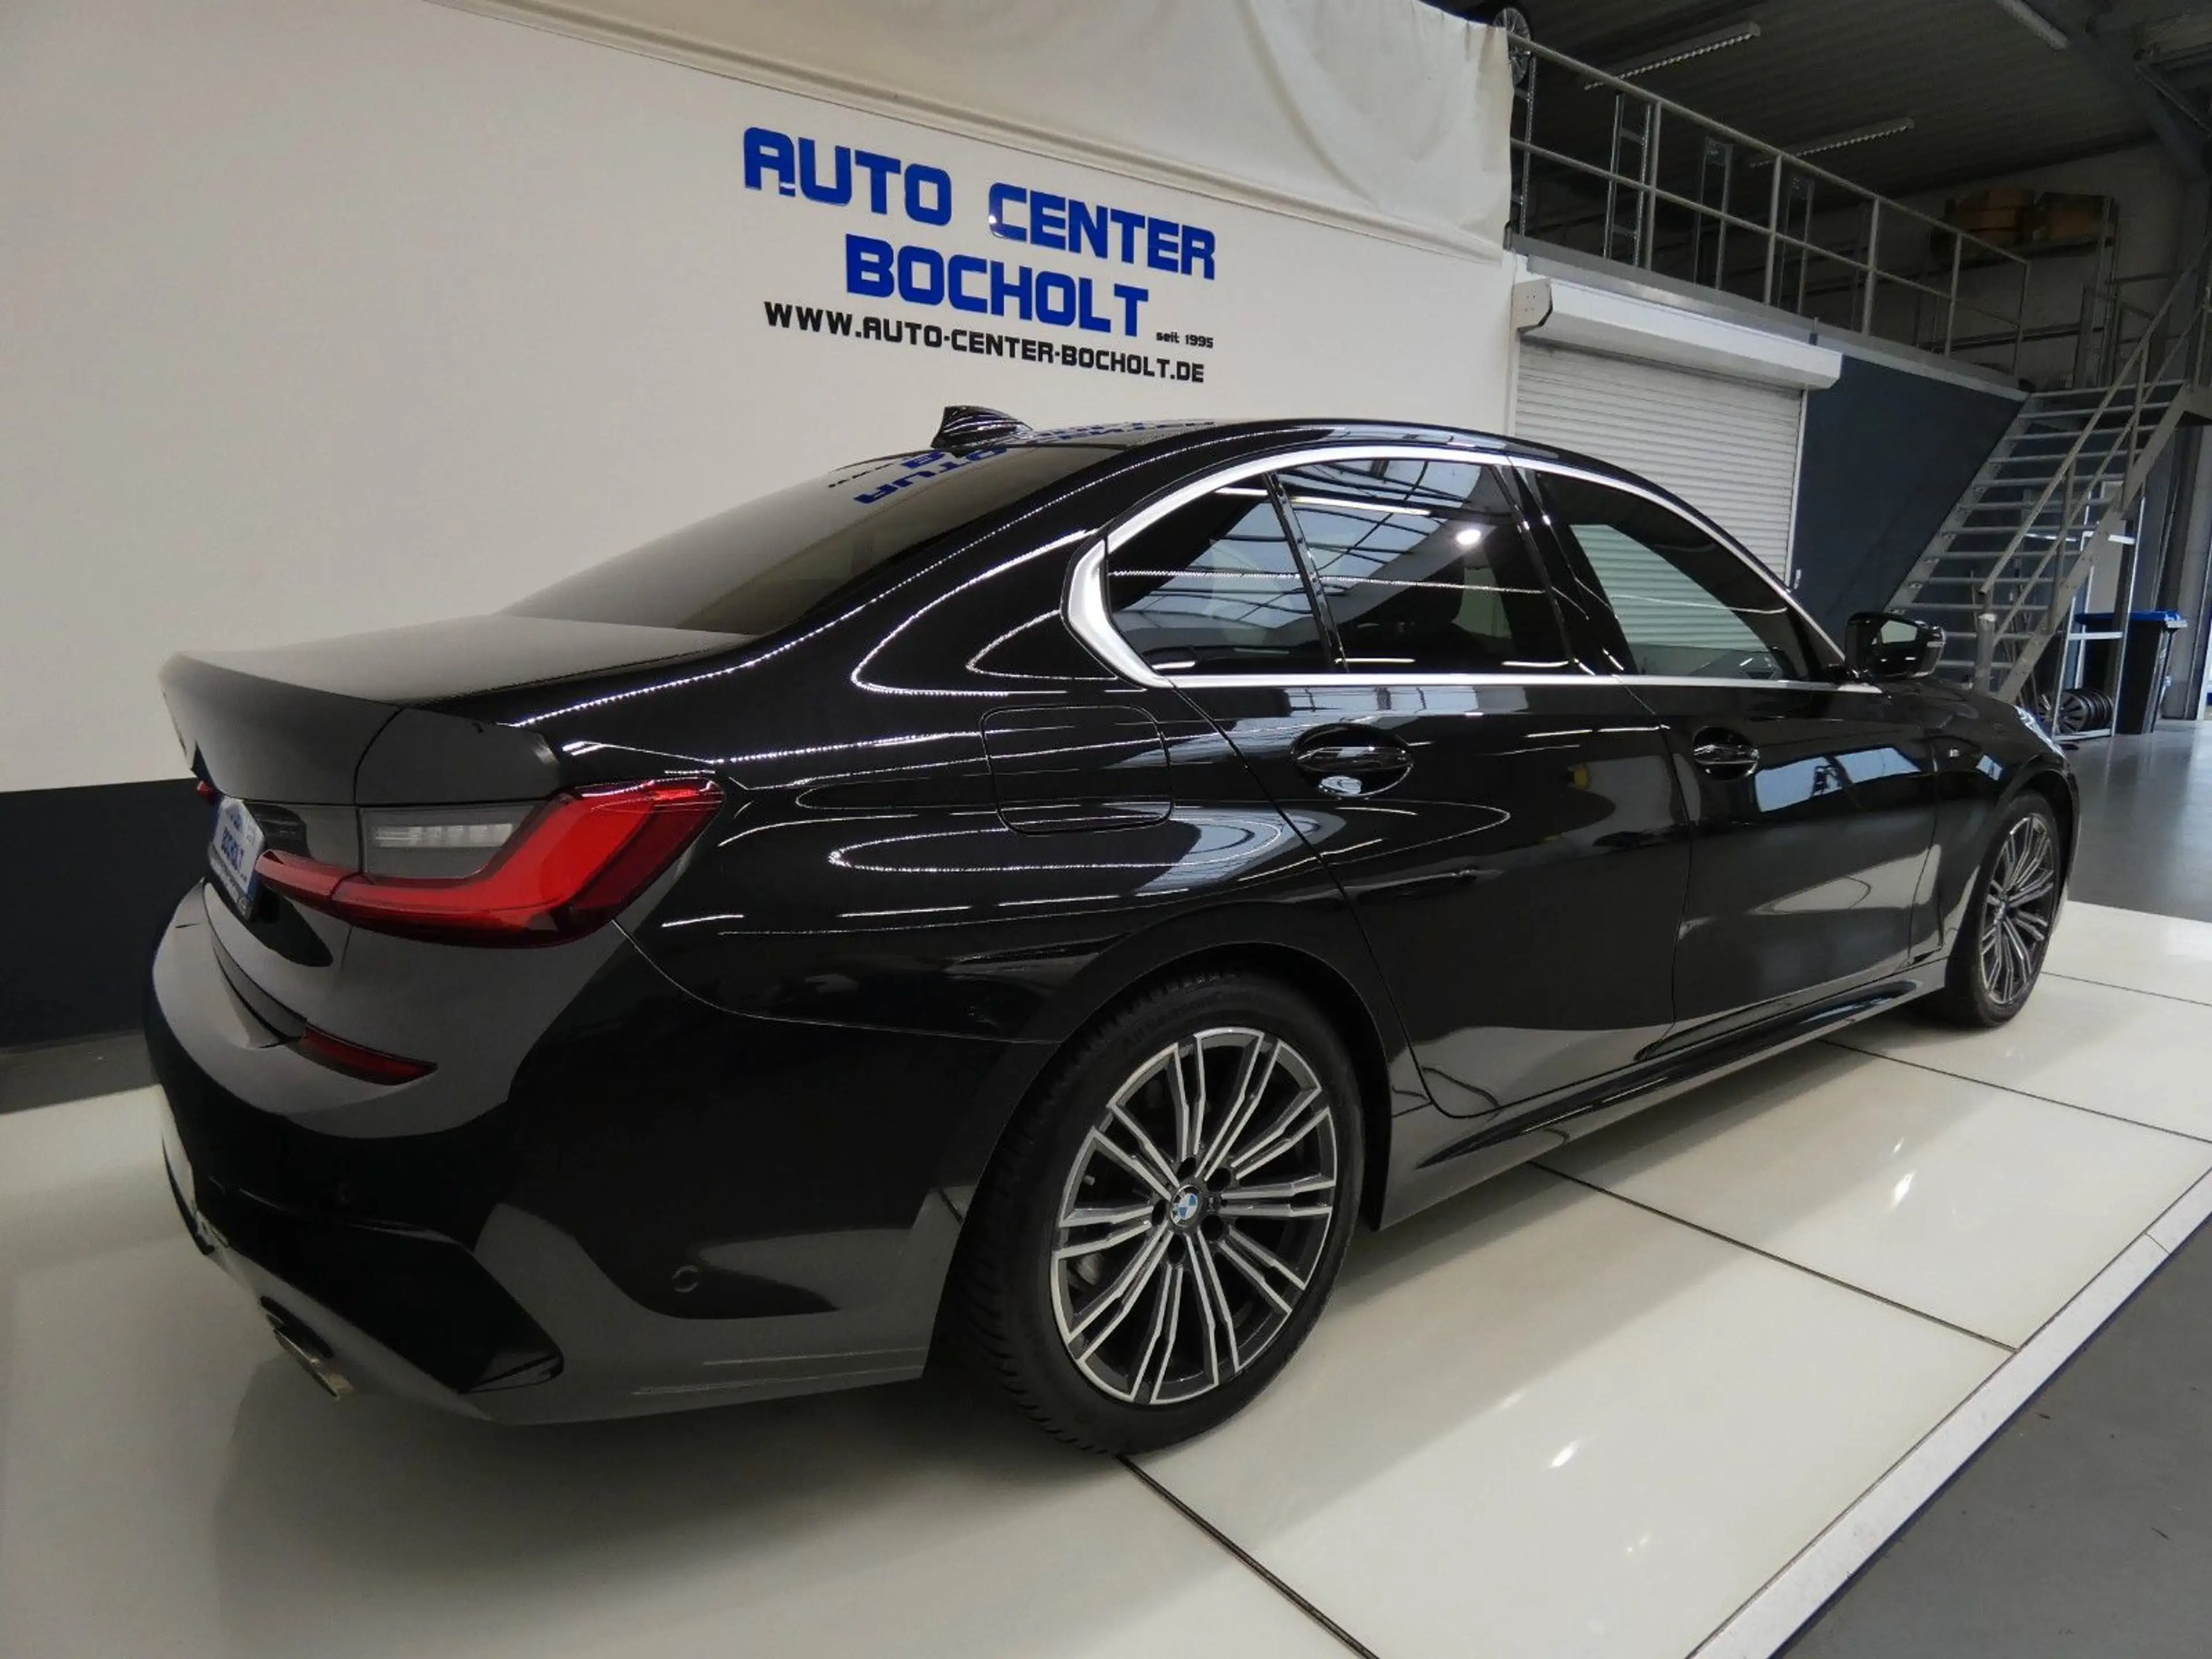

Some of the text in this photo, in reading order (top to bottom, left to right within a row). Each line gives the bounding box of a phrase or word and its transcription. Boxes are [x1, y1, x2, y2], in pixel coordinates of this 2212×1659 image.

[743, 127, 1215, 280] AUTO CENTER
[846, 234, 1149, 337] BOCHOLT
[764, 301, 1205, 383] WWW.AUTO-CENTER-BOCHOLT.DE
[1156, 331, 1214, 349] seit 1995
